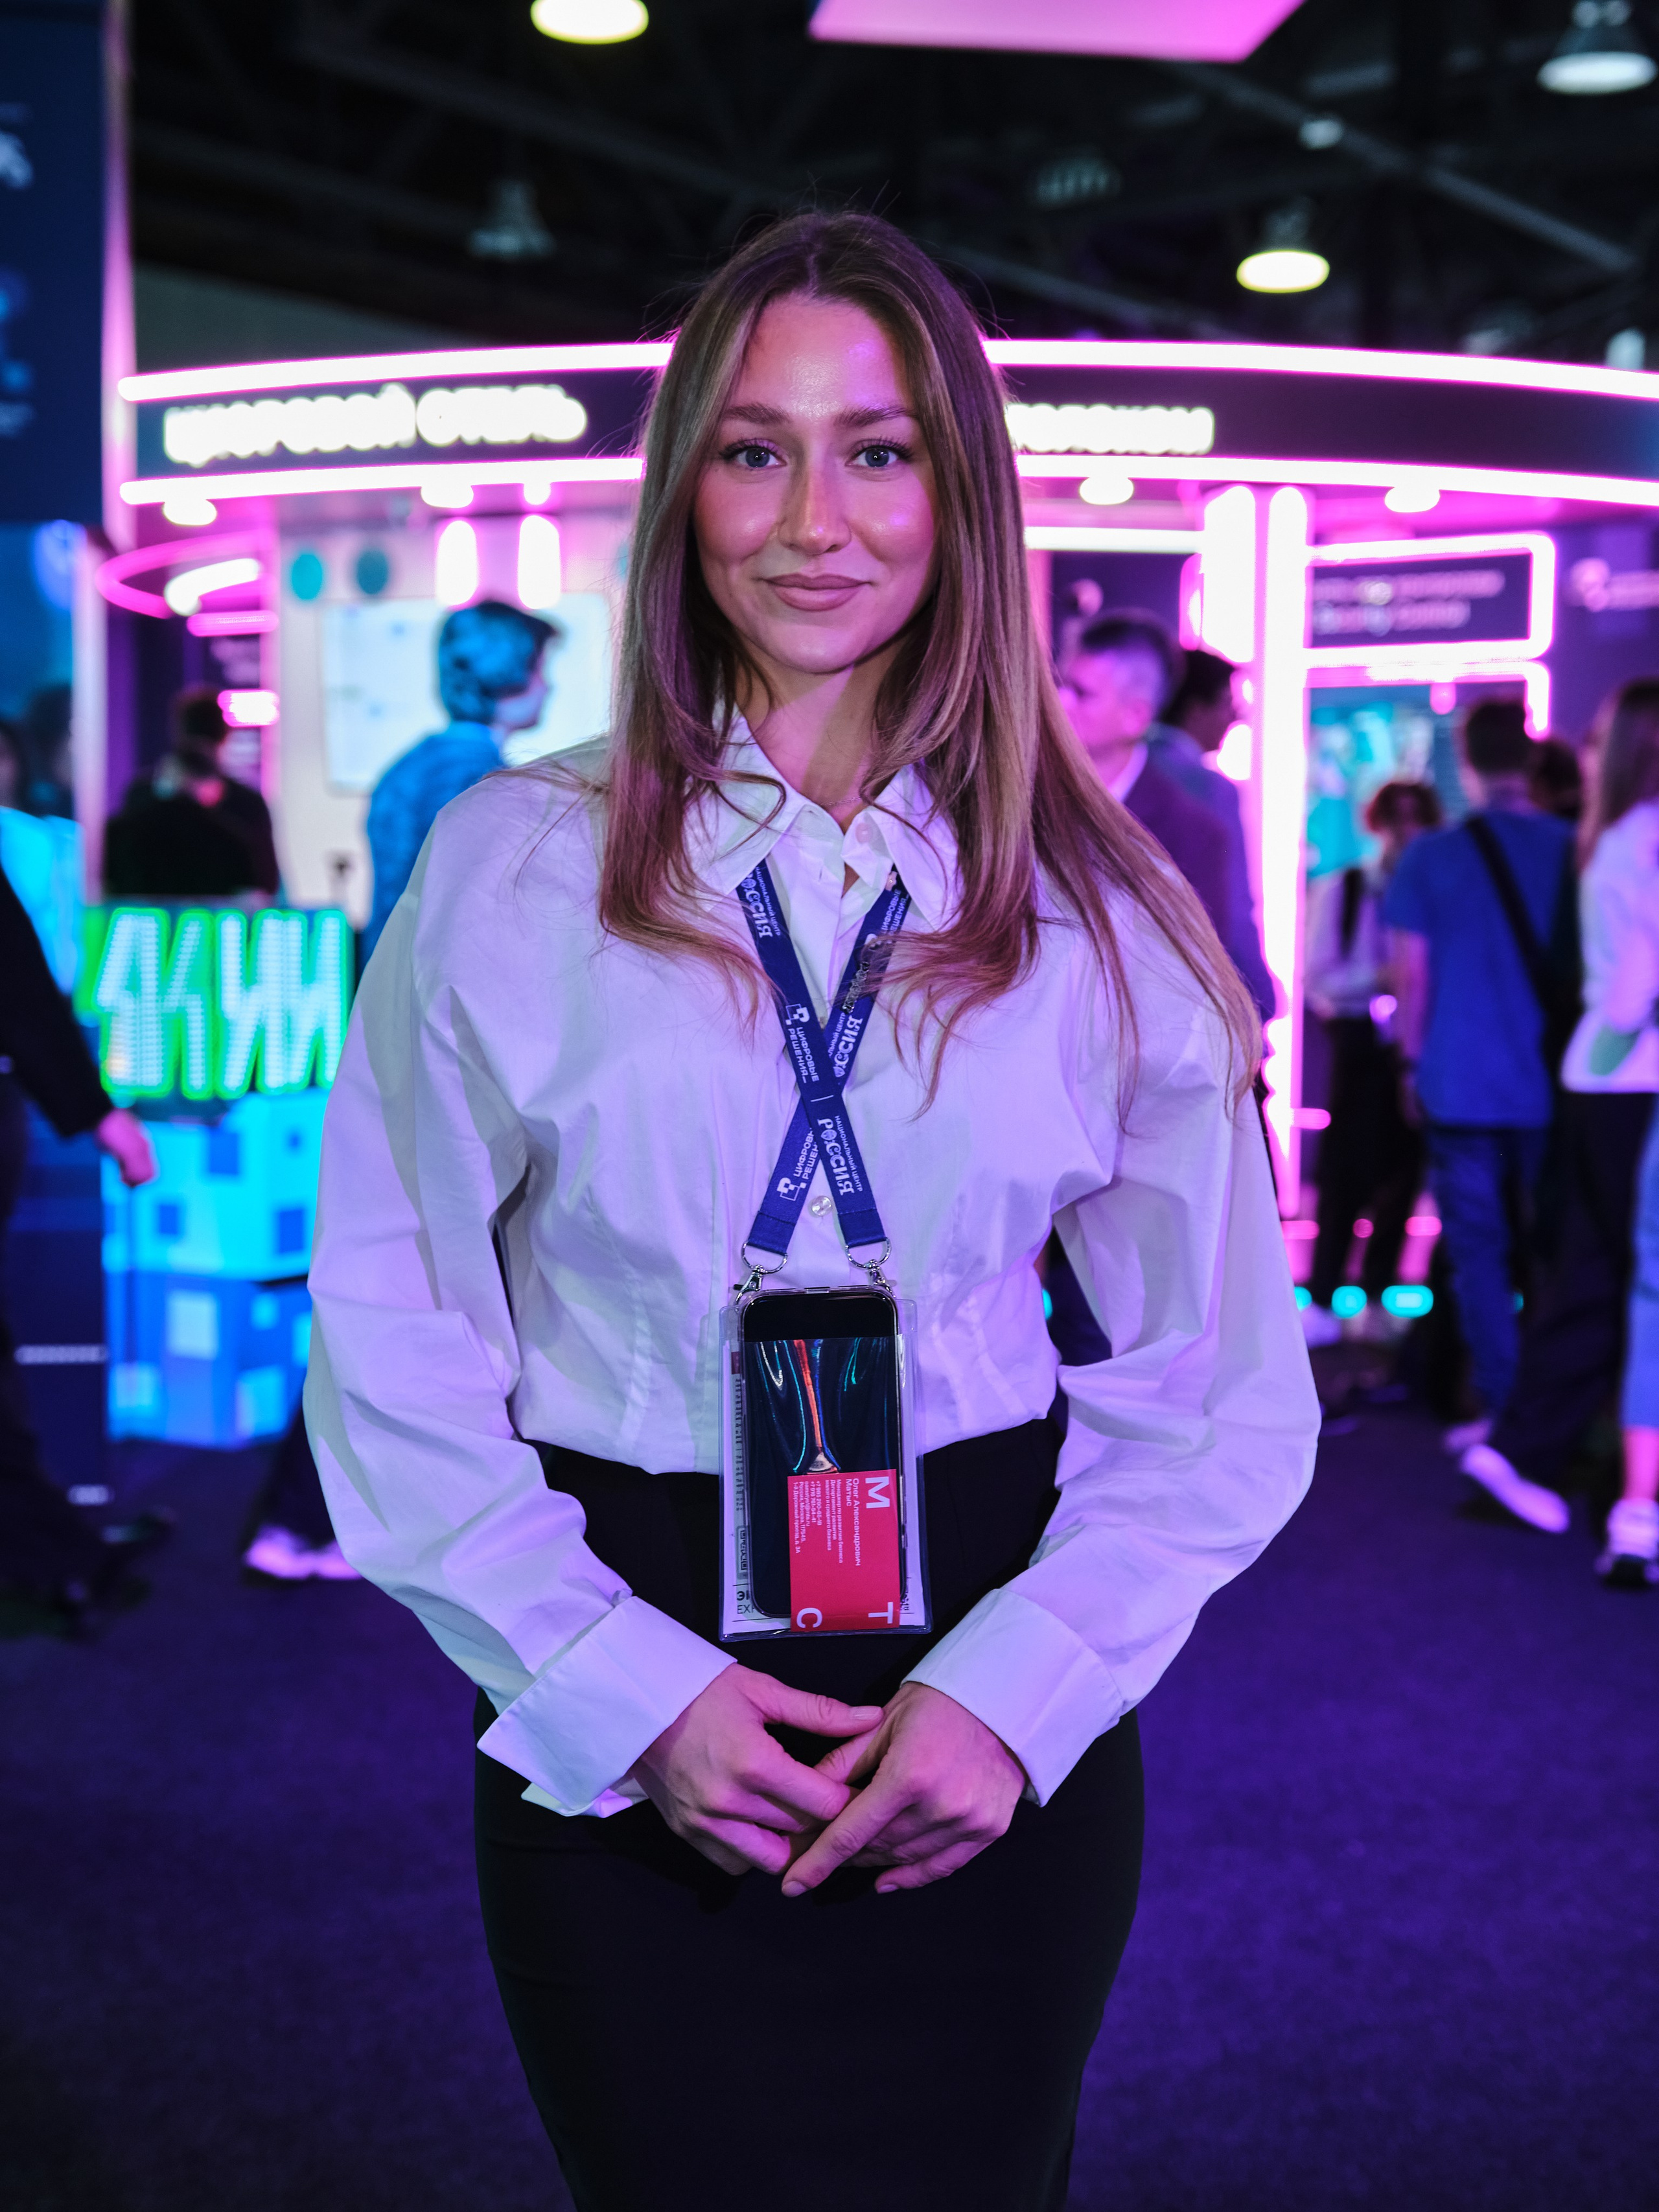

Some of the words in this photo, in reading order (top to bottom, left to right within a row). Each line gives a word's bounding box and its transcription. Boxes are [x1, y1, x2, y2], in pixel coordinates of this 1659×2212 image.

[771, 915, 781, 935] ЦЕНТР
[833, 1015, 863, 1078] ОССИЯ
[836, 1012, 845, 1032] ЦЕНТР
[796, 1027, 820, 1082] ЦИФРОВЫЕ
[817, 1118, 855, 1195] РОССИЯ
[835, 1115, 857, 1169] НАЦИОНАЛЬНЫЙ
[852, 1168, 863, 1191] ЦЕНТР
